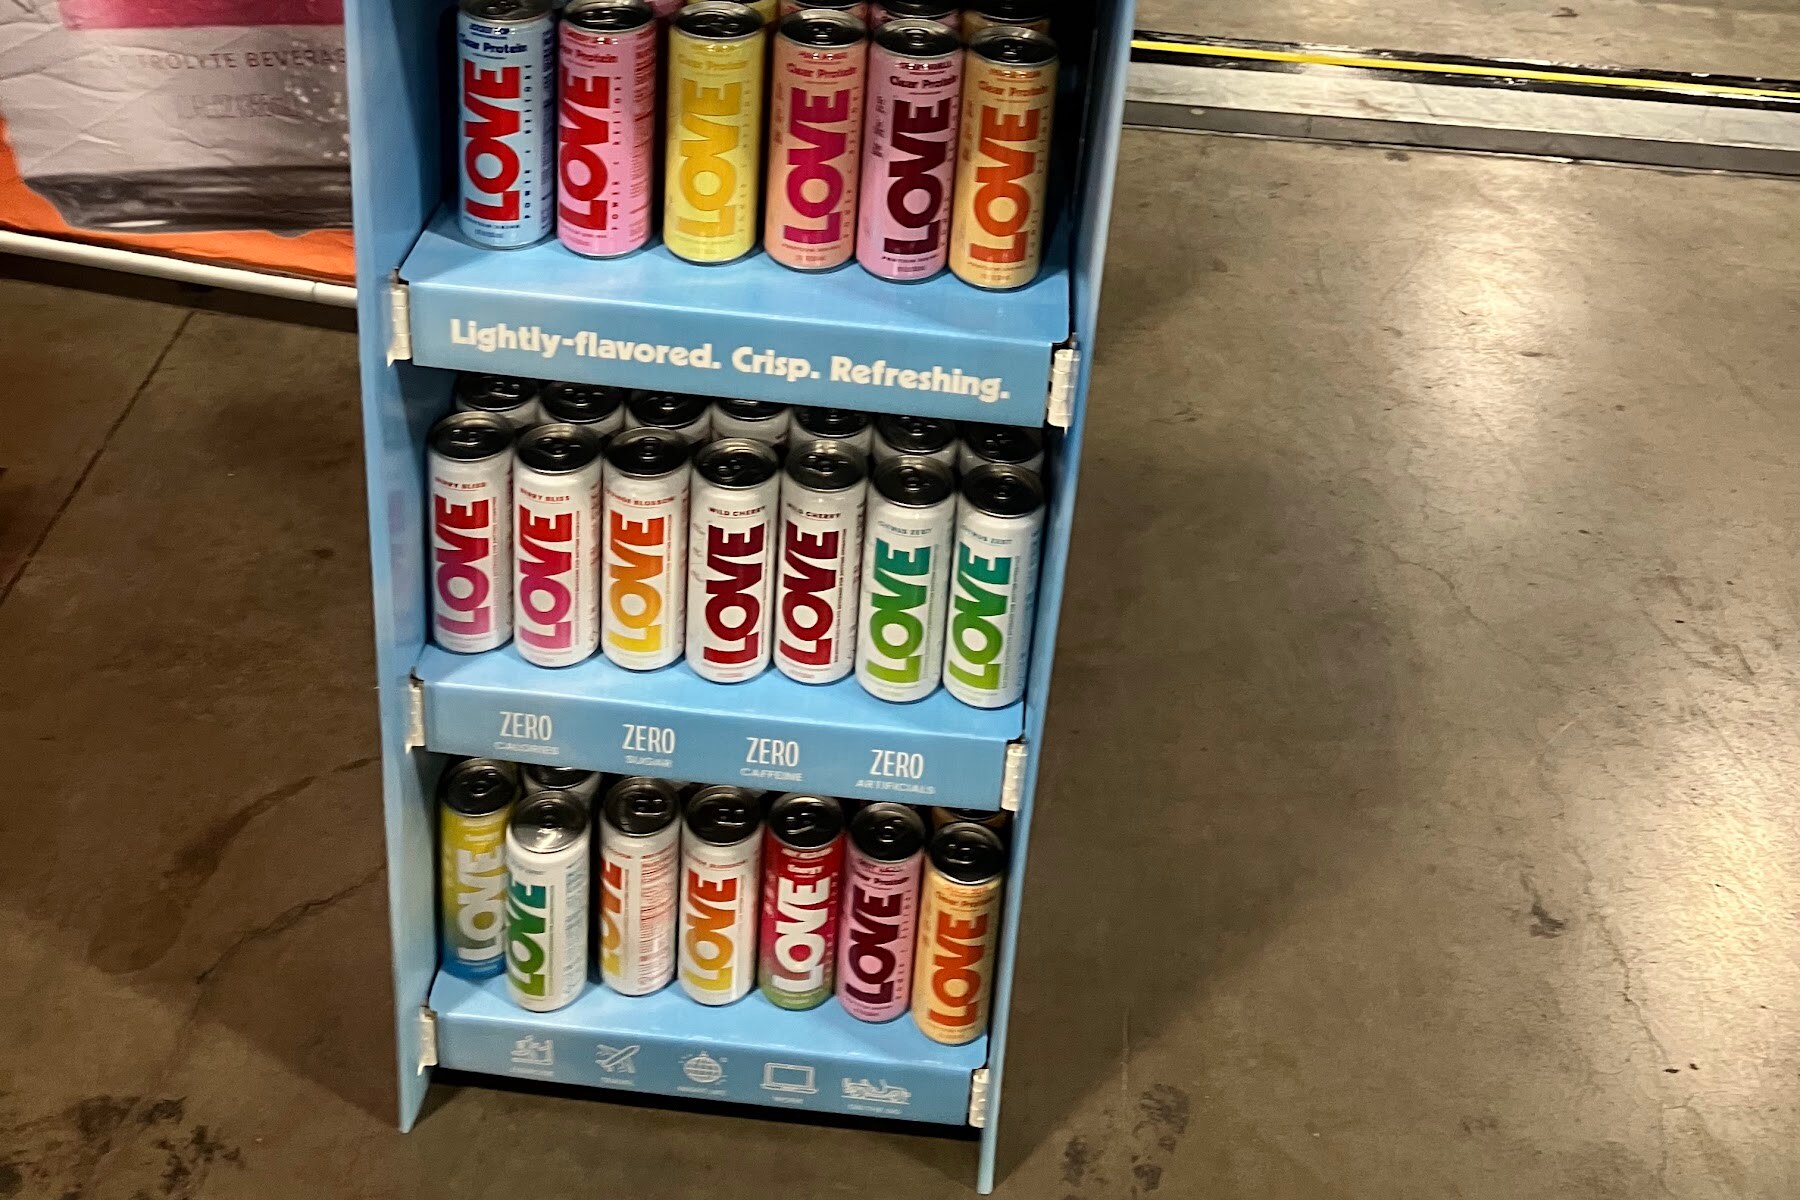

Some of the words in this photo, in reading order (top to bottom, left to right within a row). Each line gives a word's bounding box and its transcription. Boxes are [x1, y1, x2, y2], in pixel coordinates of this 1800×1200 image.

[463, 58, 520, 221] LOVE
[559, 65, 610, 231] LOVE
[676, 77, 743, 238] LOVE
[783, 86, 850, 244] LOVE
[884, 97, 950, 256] LOVE
[970, 104, 1040, 263] LOVE
[450, 318, 722, 370] Lightly-flavored.
[731, 345, 821, 382] Crisp.
[830, 355, 1011, 403] Refreshing.
[433, 494, 489, 635] LOVE
[518, 504, 573, 649] LOVE
[607, 509, 665, 652] LOVE
[703, 523, 765, 664] LOVE
[779, 520, 839, 665] LOVE
[865, 537, 932, 684] LOVE
[949, 541, 1012, 691] LOVE
[499, 711, 553, 741] ZERO
[621, 724, 676, 754] ZERO
[745, 737, 799, 767] ZERO
[869, 749, 925, 780] ZERO
[457, 844, 509, 960] LOVE
[507, 870, 547, 997] LOVE
[682, 867, 738, 991] LOVE
[771, 876, 831, 993] LOVE
[845, 884, 902, 1004] LOVE
[928, 910, 989, 1027] LOVE
